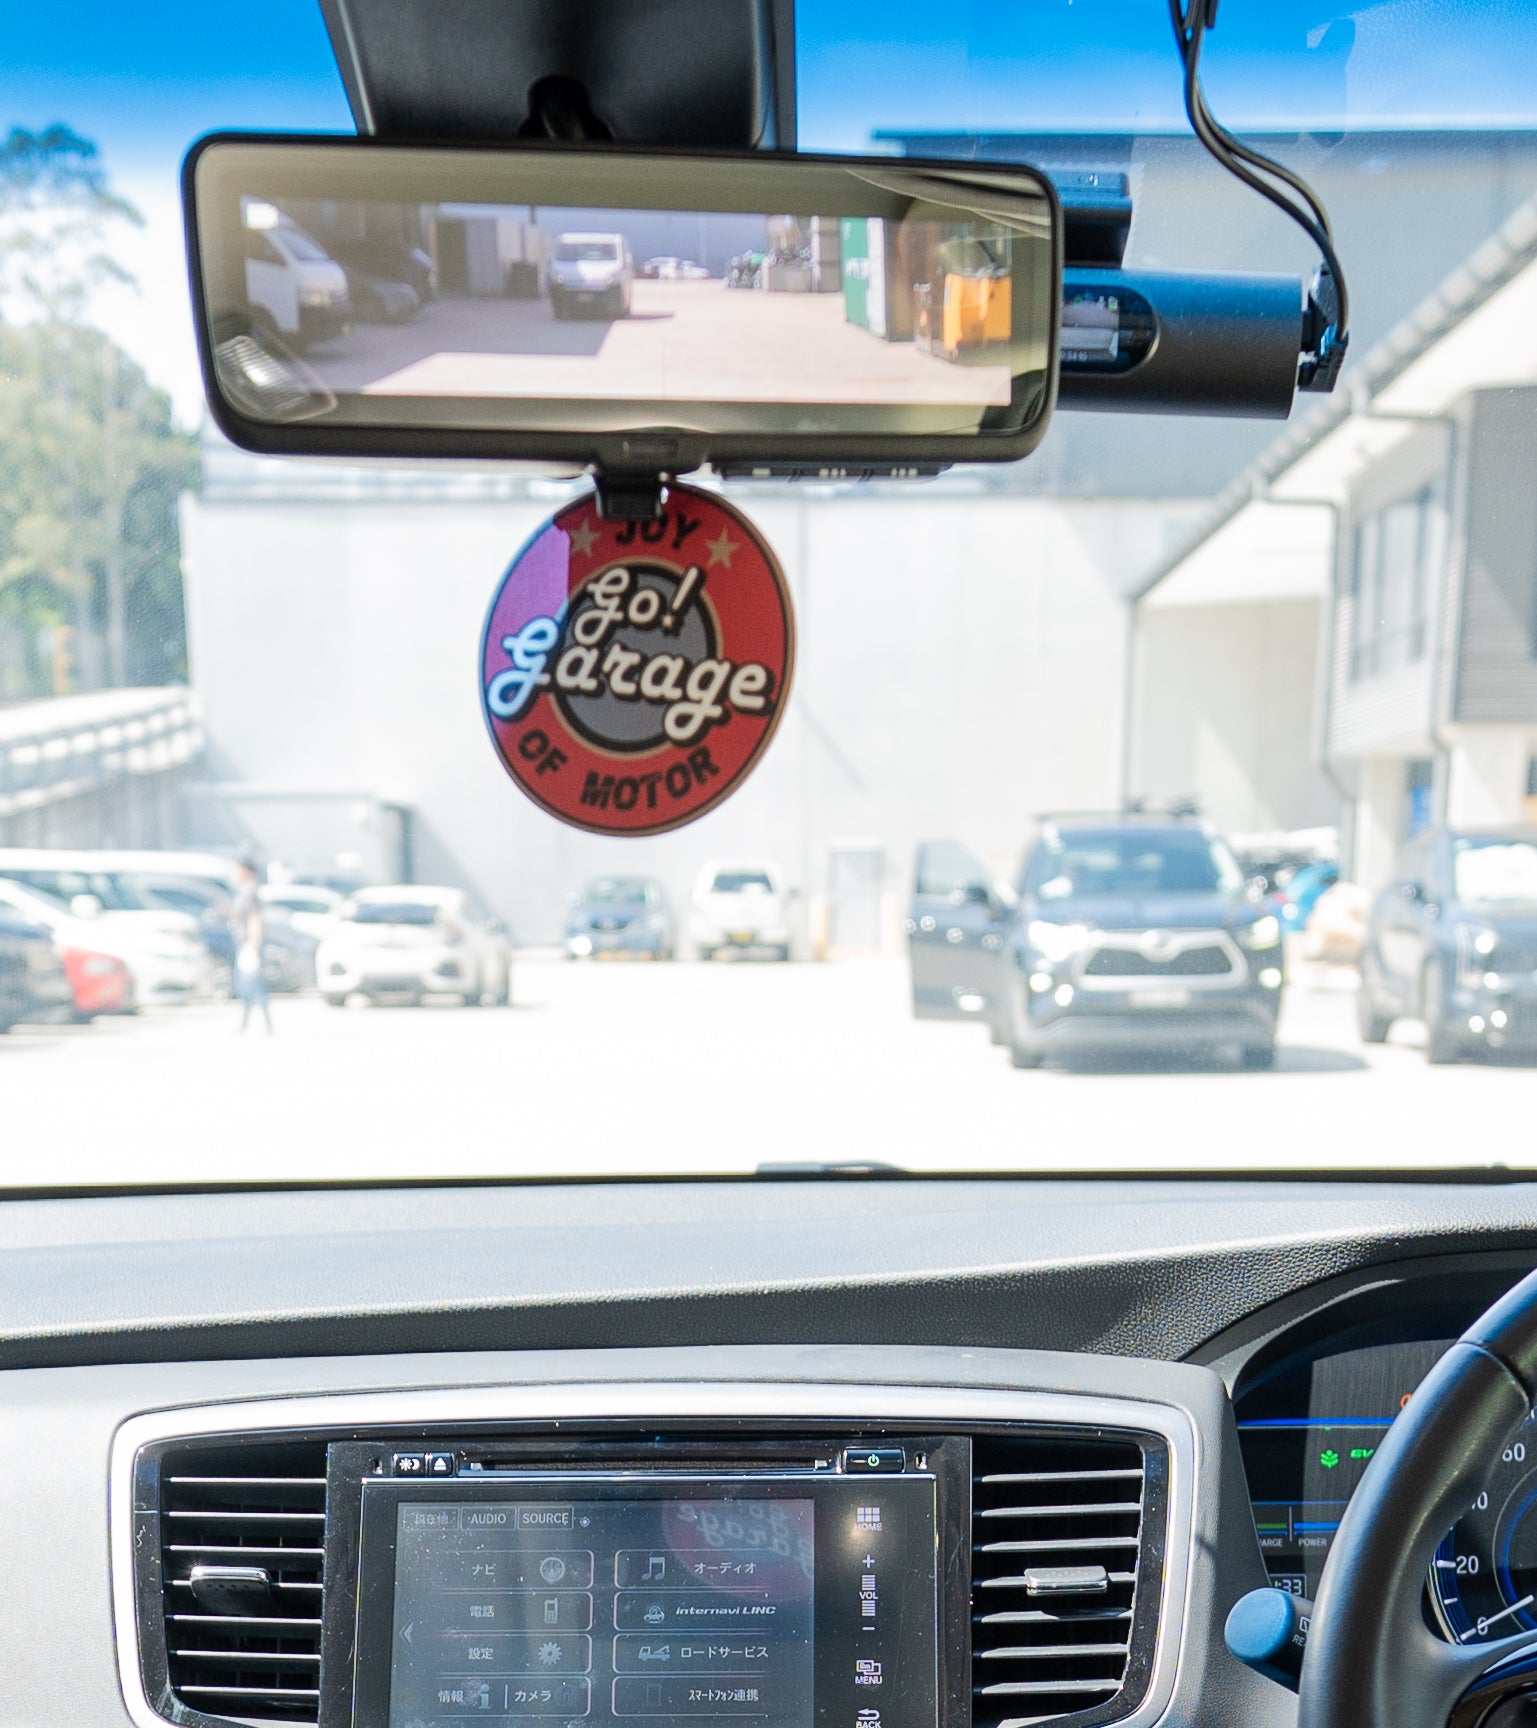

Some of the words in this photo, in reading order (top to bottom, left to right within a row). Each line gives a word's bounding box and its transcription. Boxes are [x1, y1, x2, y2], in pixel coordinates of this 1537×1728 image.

[573, 566, 700, 646] Go!
[487, 616, 767, 740] Garage
[518, 729, 569, 776] OF
[579, 745, 720, 811] MOTOR
[1502, 1442, 1526, 1462] 60
[1471, 1491, 1489, 1510] 0
[470, 1512, 507, 1525] AUDIO
[522, 1512, 570, 1525] SOURCE
[855, 1522, 883, 1532] HOME
[1259, 1538, 1283, 1547] ARGE
[1297, 1538, 1327, 1547] POWER
[471, 1563, 497, 1576] ナビ
[694, 1562, 757, 1575] オーディオ
[1456, 1555, 1479, 1573] 20
[859, 1591, 879, 1600] VOL
[469, 1605, 495, 1618] 電話
[675, 1605, 741, 1615] internavi
[742, 1605, 777, 1615] LINC
[468, 1647, 494, 1660] 設定
[680, 1646, 769, 1658] ロードサービス
[855, 1675, 883, 1685] MENU
[438, 1689, 465, 1703] 情報
[514, 1689, 552, 1702] カメラ
